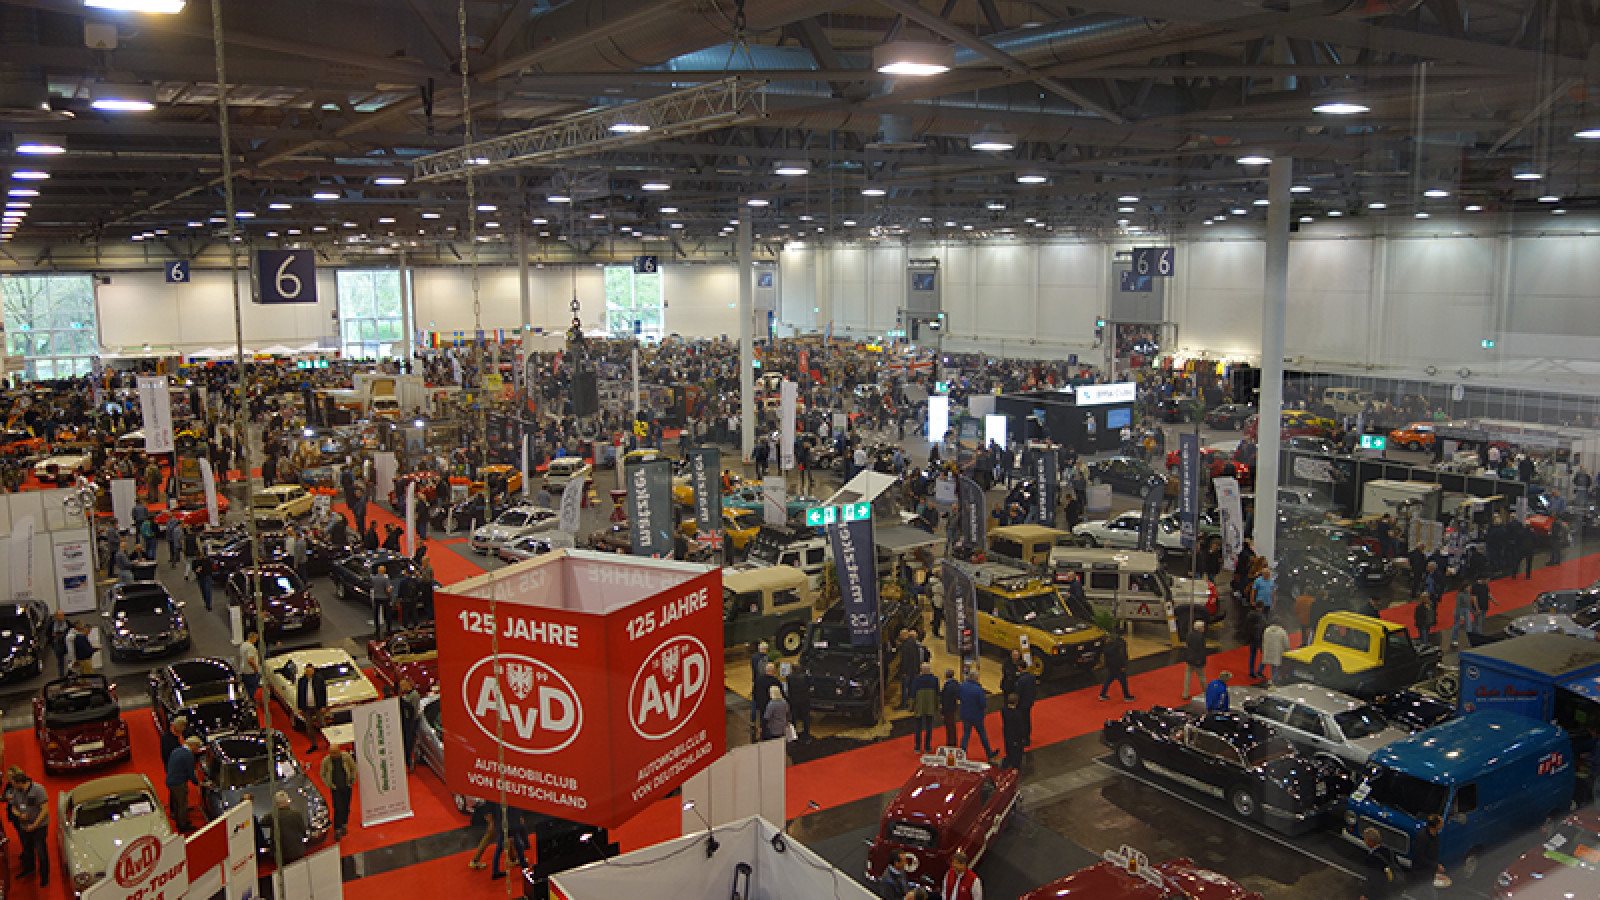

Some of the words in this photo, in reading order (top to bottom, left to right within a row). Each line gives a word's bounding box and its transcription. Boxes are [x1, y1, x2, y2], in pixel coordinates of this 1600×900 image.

[171, 262, 184, 281] 6
[644, 257, 654, 272] 6
[1137, 250, 1149, 274] 6
[1158, 250, 1170, 274] 6
[276, 255, 302, 298] 6
[626, 610, 655, 641] 125
[660, 586, 708, 628] JAHRE
[457, 610, 496, 635] 125
[503, 616, 578, 648] JAHRE
[475, 758, 577, 790] AUTOMOBILCLUB
[467, 772, 494, 788] VON
[496, 779, 587, 810] DEUTSCHLAND
[632, 781, 652, 801] VON
